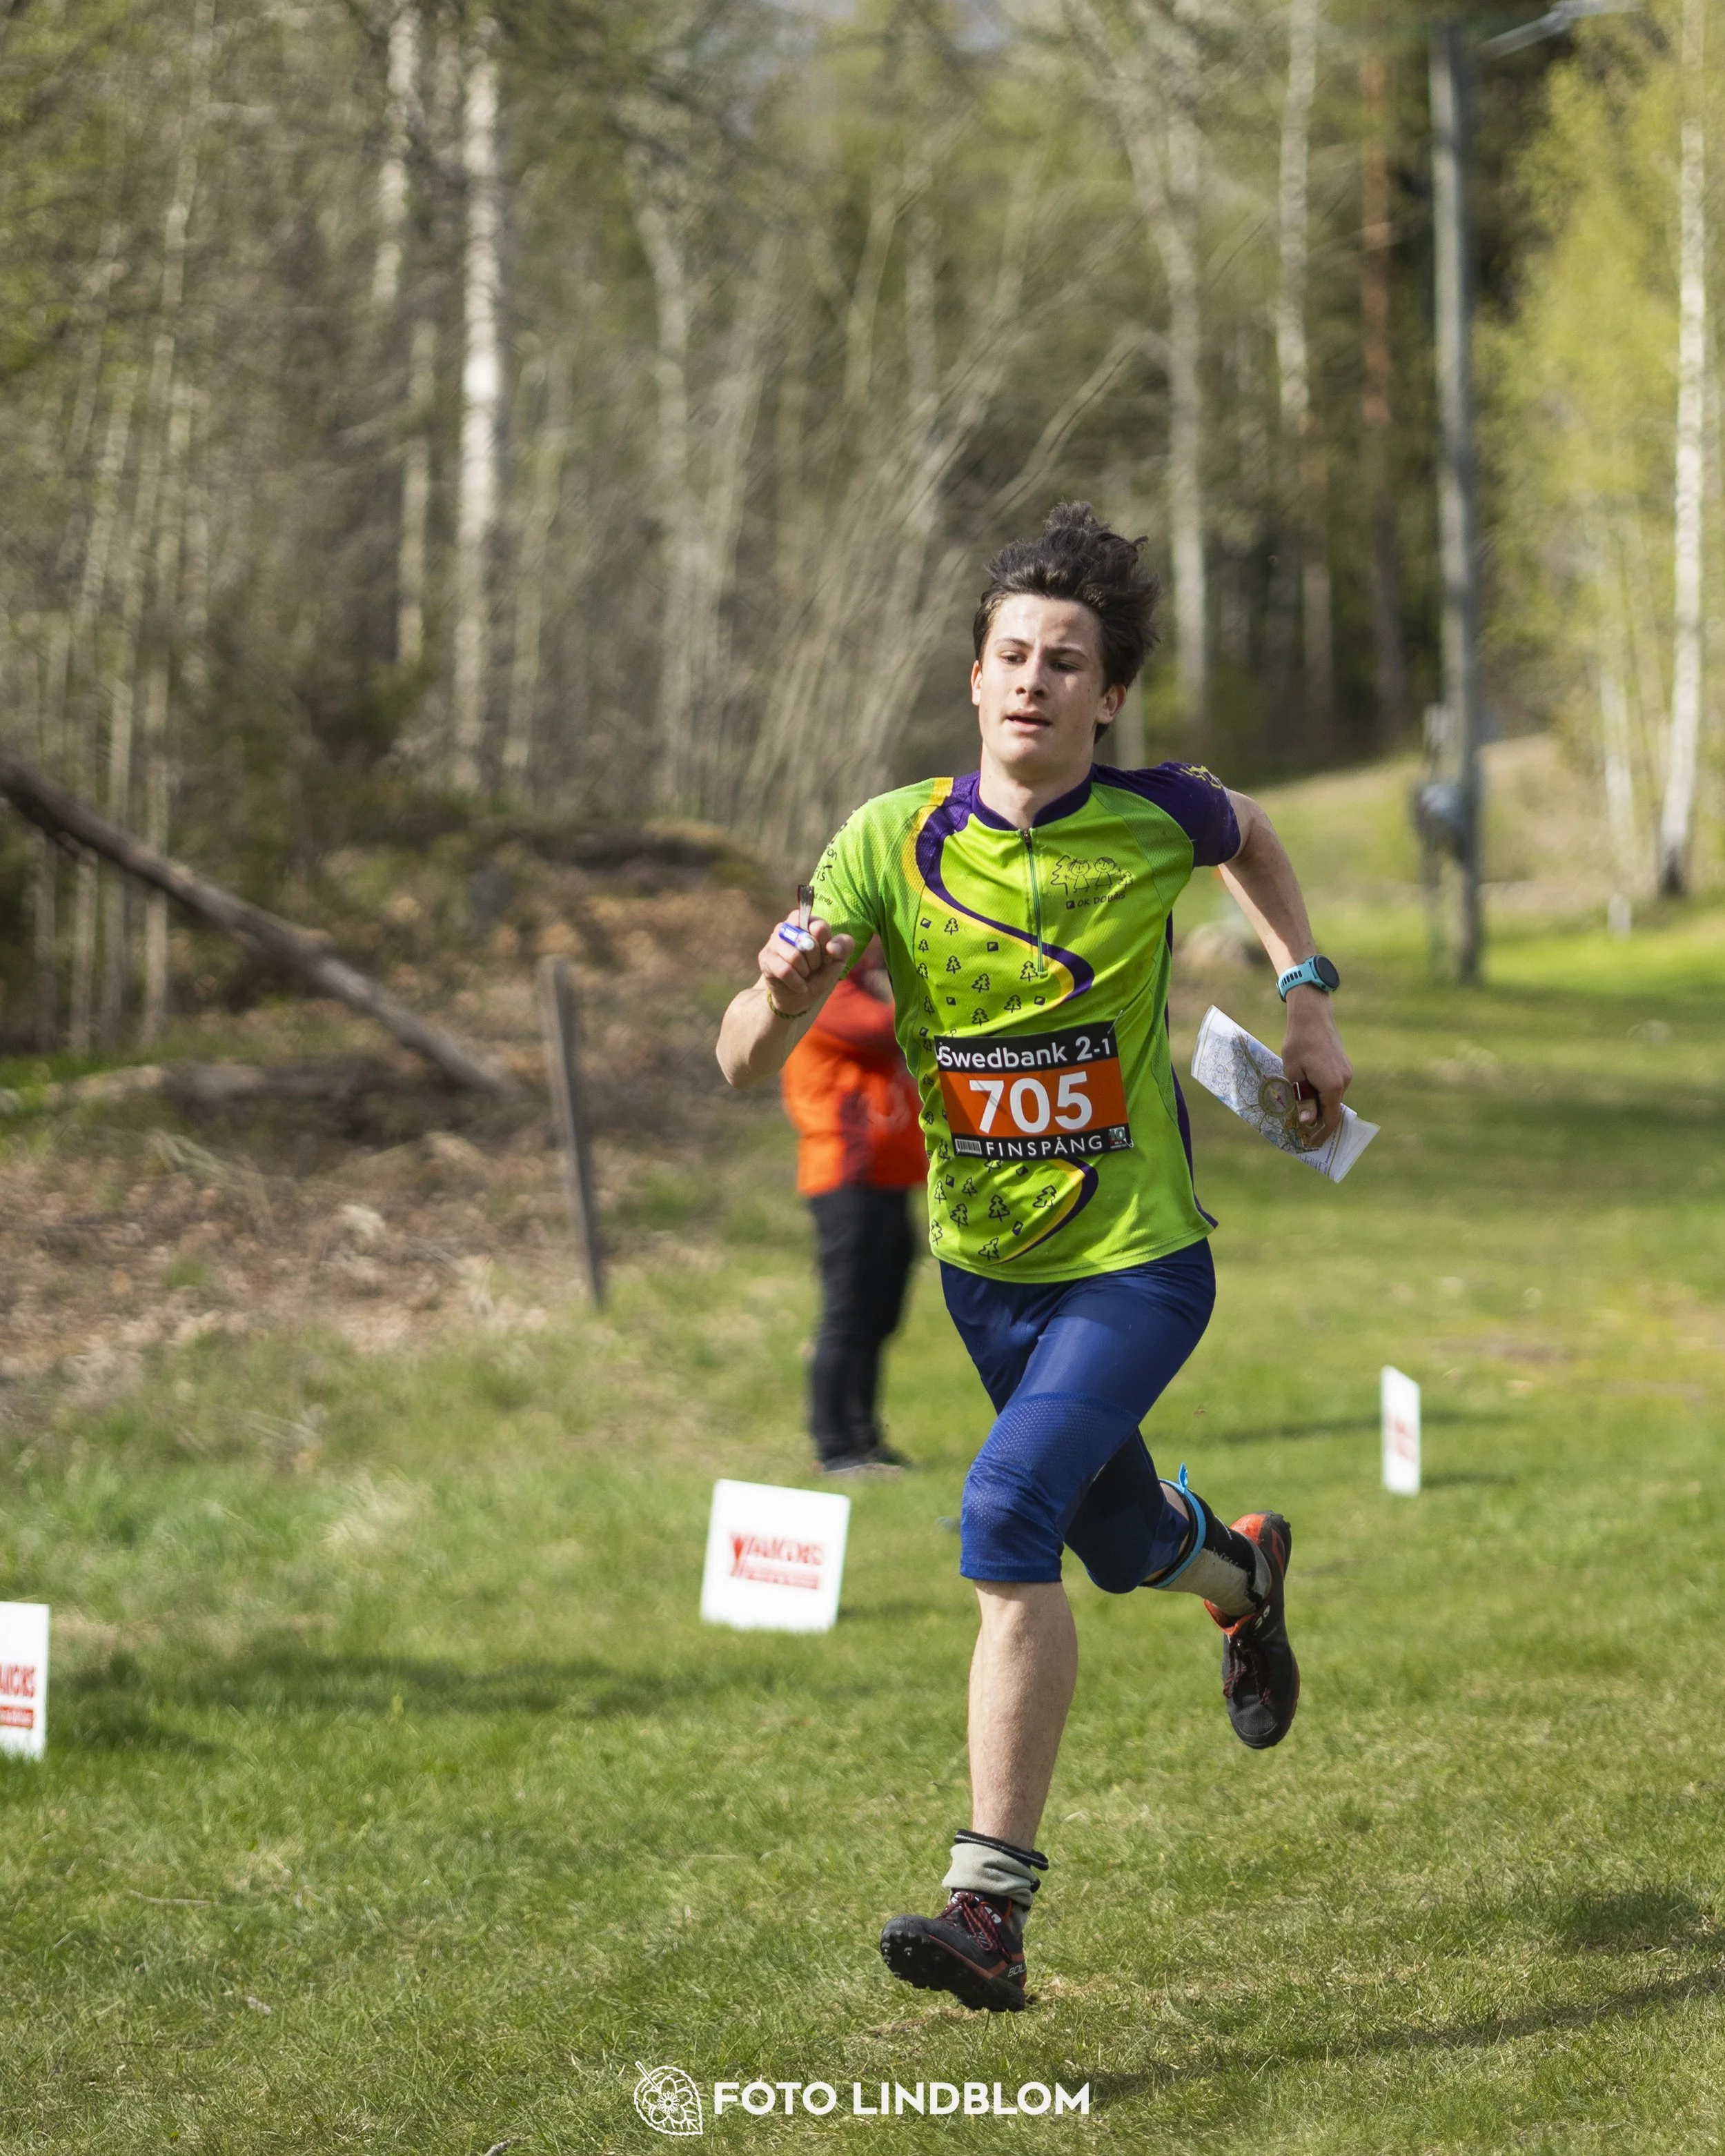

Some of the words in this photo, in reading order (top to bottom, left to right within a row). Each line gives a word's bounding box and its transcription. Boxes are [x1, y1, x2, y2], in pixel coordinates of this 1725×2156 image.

[939, 1042, 1068, 1067] Swedbank
[968, 1071, 1093, 1134] 705
[986, 1135, 1103, 1156] FINSPÅNG
